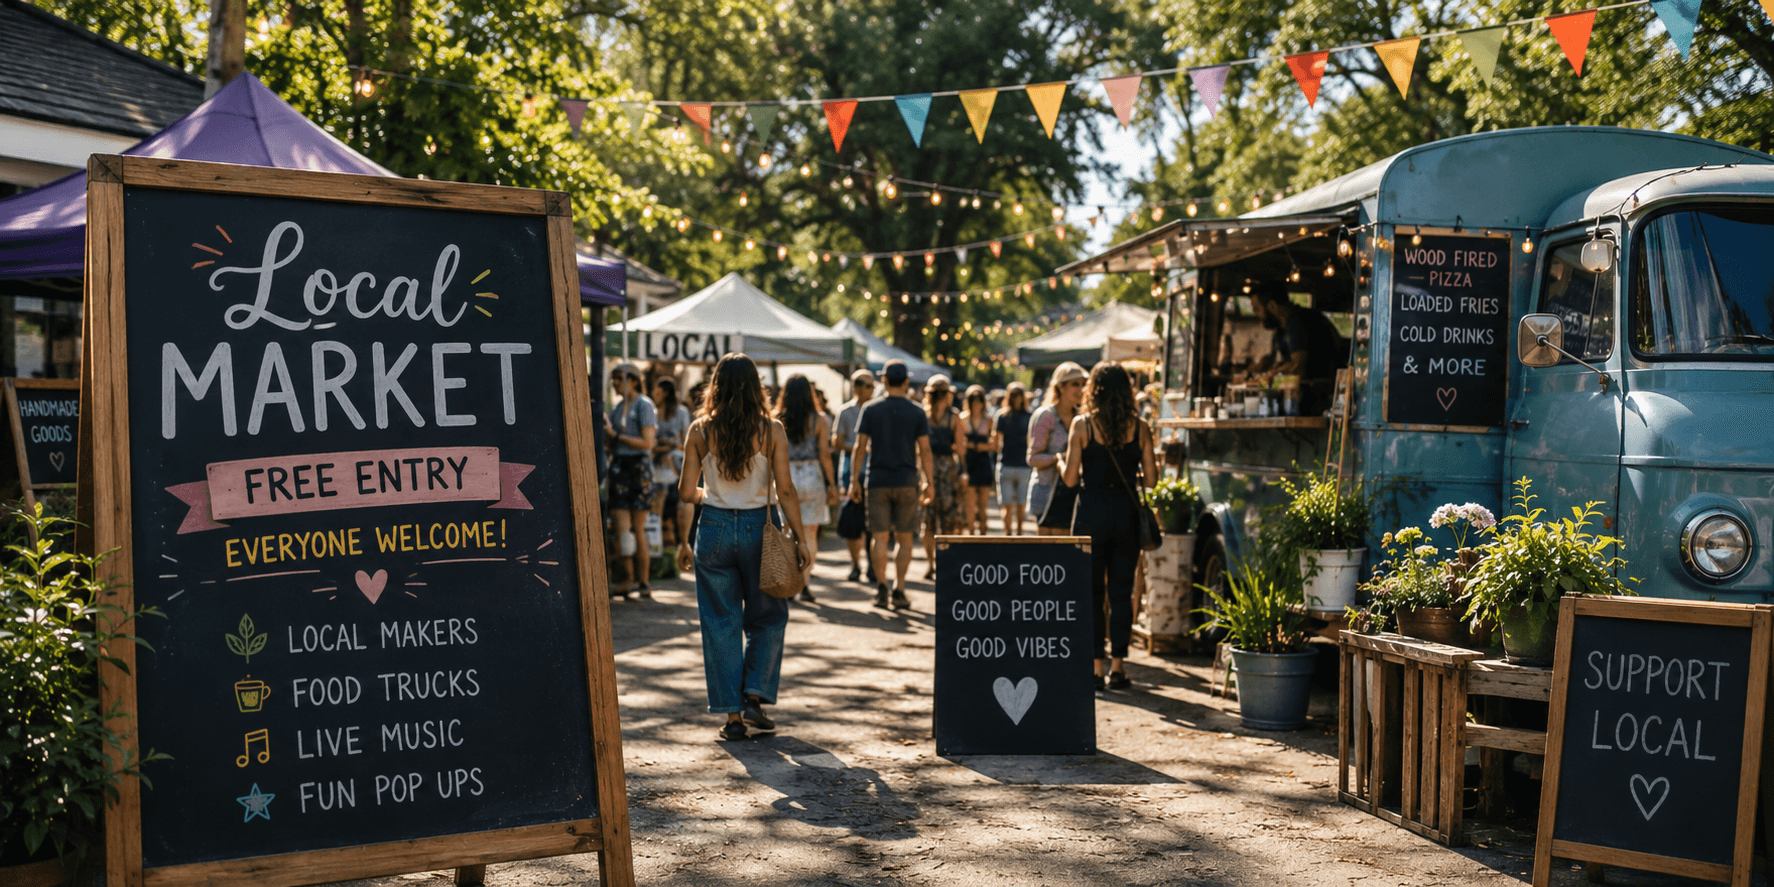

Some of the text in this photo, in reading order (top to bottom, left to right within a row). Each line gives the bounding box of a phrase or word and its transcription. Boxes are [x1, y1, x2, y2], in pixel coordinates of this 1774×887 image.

[1405, 249, 1497, 267] WOOD FIRED
[208, 221, 467, 331] Local
[1430, 271, 1472, 287] PIZZA
[1401, 295, 1498, 314] LOADED FRIES
[1400, 326, 1493, 344] COLD DRINKS
[1403, 356, 1485, 375] & MORE
[162, 341, 532, 439] MARKET
[19, 400, 79, 417] HANDMADE
[31, 425, 72, 443] GOODS
[245, 456, 468, 504] FREE ENTRY
[226, 519, 506, 567] EVERYONE WELCOME!
[961, 564, 1065, 585] GOOD FOOD
[952, 600, 1076, 621] GOOD PEOPLE
[289, 618, 477, 653] LOCAL MAKERS
[956, 637, 1070, 659] GOOD VIBES
[293, 669, 479, 707] FOOD TRUCKS
[1585, 651, 1730, 700] SUPPORT
[298, 719, 463, 758] LIVE MUSIC
[1592, 710, 1715, 761] LOCAL
[300, 768, 483, 813] FUN POP UPS
